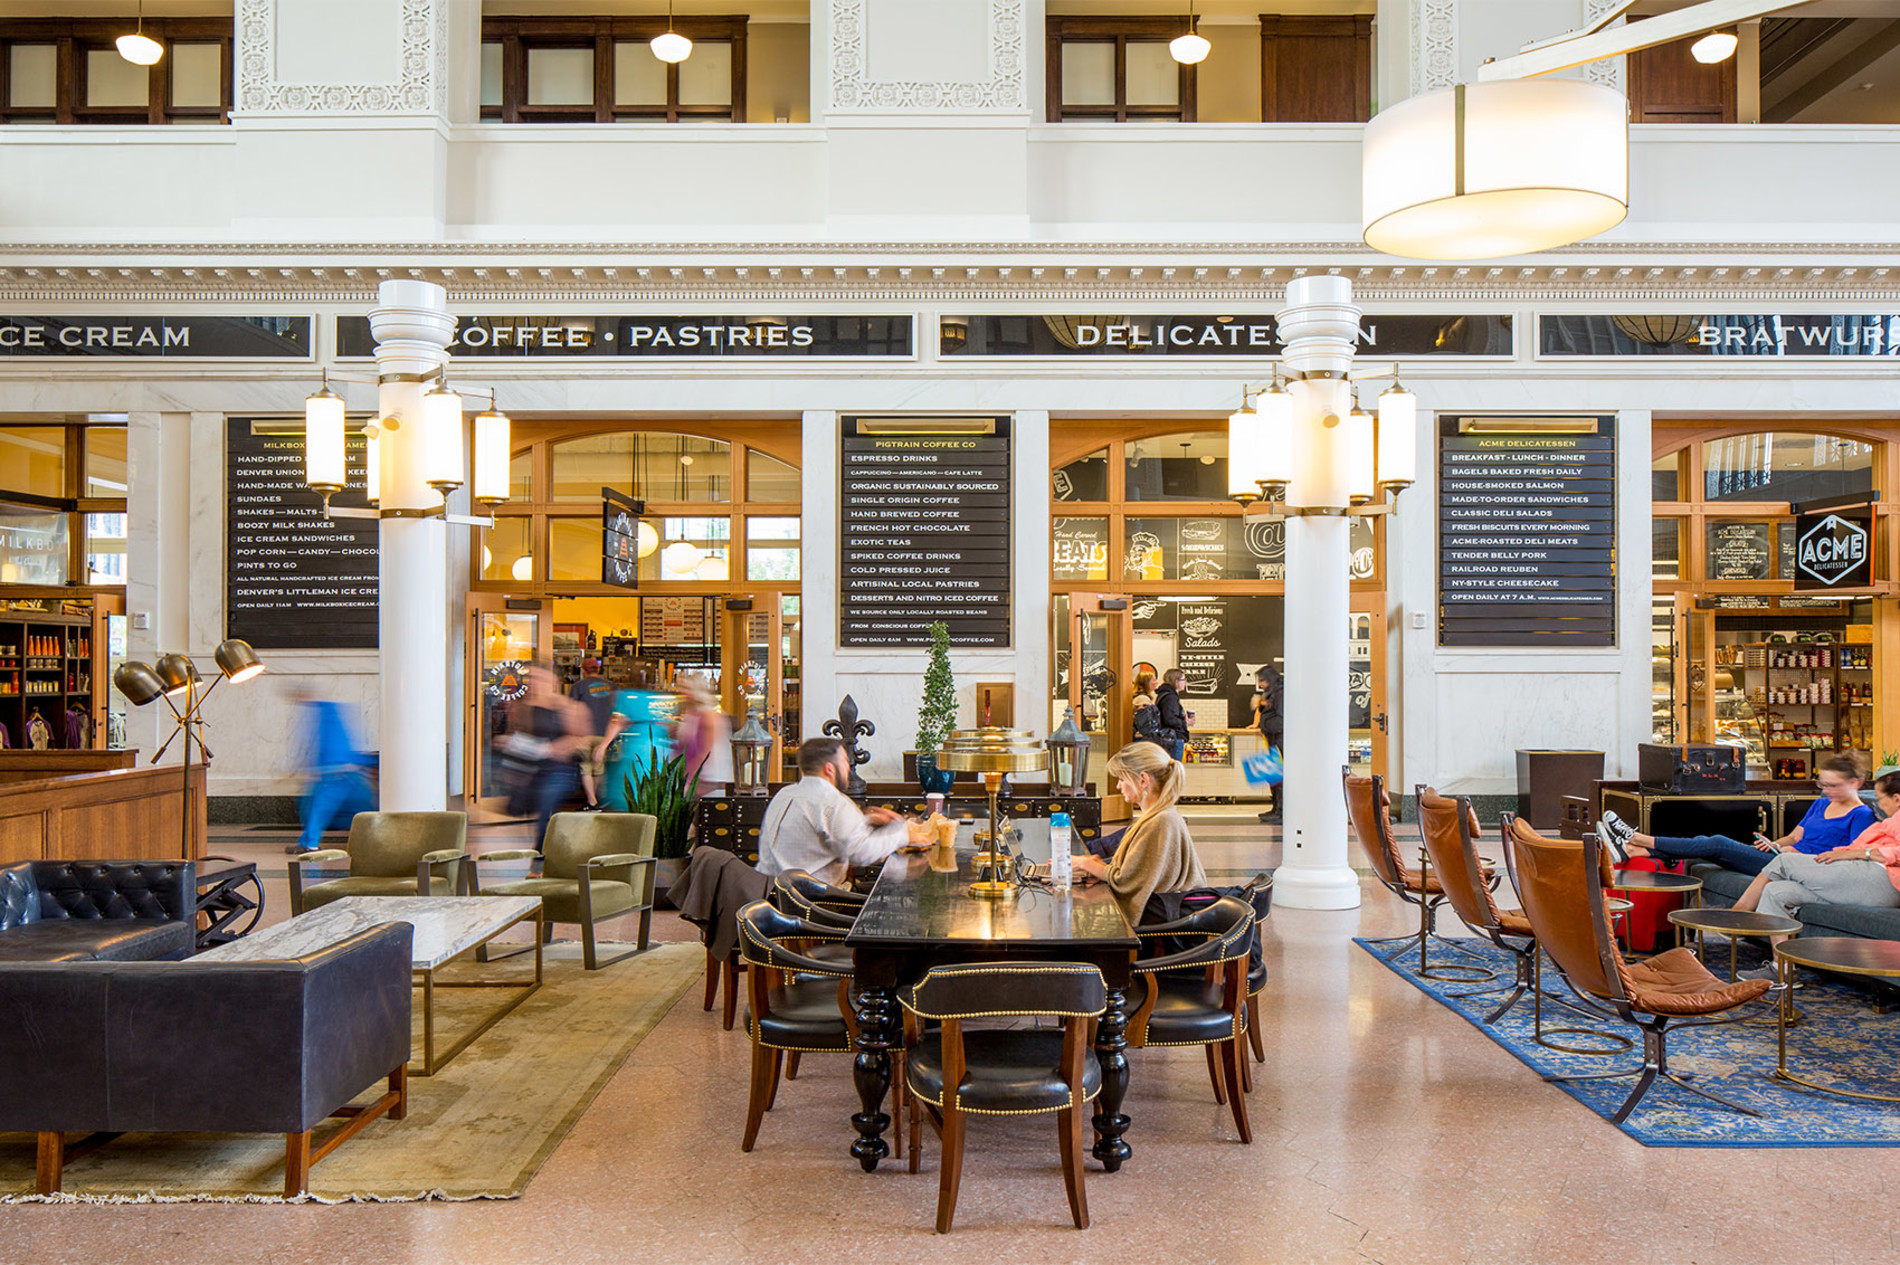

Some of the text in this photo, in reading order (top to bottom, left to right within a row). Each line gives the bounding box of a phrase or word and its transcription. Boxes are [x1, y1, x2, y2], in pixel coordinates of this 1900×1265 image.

[0, 325, 191, 348] CE CREAM
[629, 325, 815, 347] PASTRIES
[237, 455, 303, 463] HAND-DIPPED
[237, 495, 282, 503] SUNDAES
[851, 496, 960, 504] SINGLE ORIGIN COFFEE
[1527, 496, 1589, 504] SANDWICHES
[1450, 509, 1491, 517] CLASSIC
[1492, 509, 1514, 517] DELI
[297, 521, 335, 529] SHAKES
[850, 524, 971, 532] FRENCH HOT CHOCOLATE
[1451, 523, 1481, 531] FRESH
[1481, 523, 1520, 531] BISCUITS
[255, 535, 289, 543] CREAM
[291, 534, 356, 542] SANDWICHES
[850, 538, 885, 546] EXOTIC
[236, 548, 257, 556] POP
[1802, 534, 1863, 564] ACME
[886, 552, 924, 560] COFFEE
[282, 561, 297, 569] GO
[1451, 565, 1499, 573] RAILROAD
[1813, 561, 1849, 571] DELICATESSEN
[850, 566, 877, 574] COLD
[850, 580, 980, 588] ARTISINAL LOCAL PASTRIES
[1451, 579, 1559, 587] NY-STYLE CHEESECAKE
[237, 588, 284, 596] DENVER'S
[1185, 637, 1221, 648] Salads
